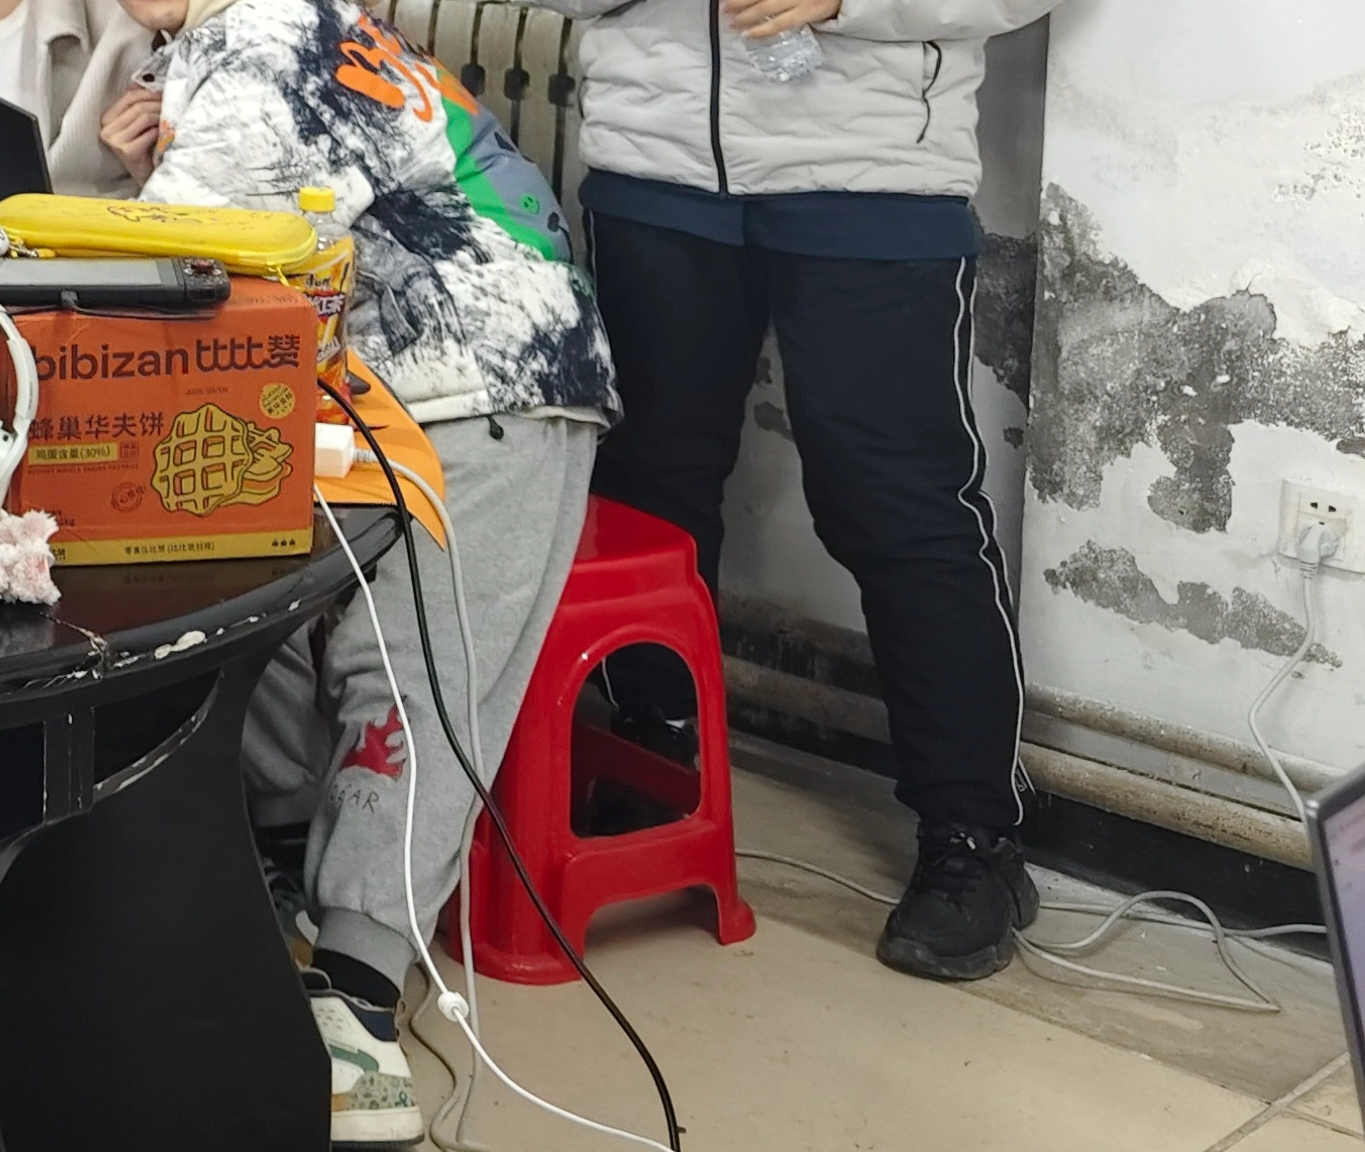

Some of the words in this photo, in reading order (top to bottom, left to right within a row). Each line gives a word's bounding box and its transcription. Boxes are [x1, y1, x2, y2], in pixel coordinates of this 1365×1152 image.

[30, 342, 189, 381] bibizan
[29, 411, 165, 441] 蜂巢华夫饼
